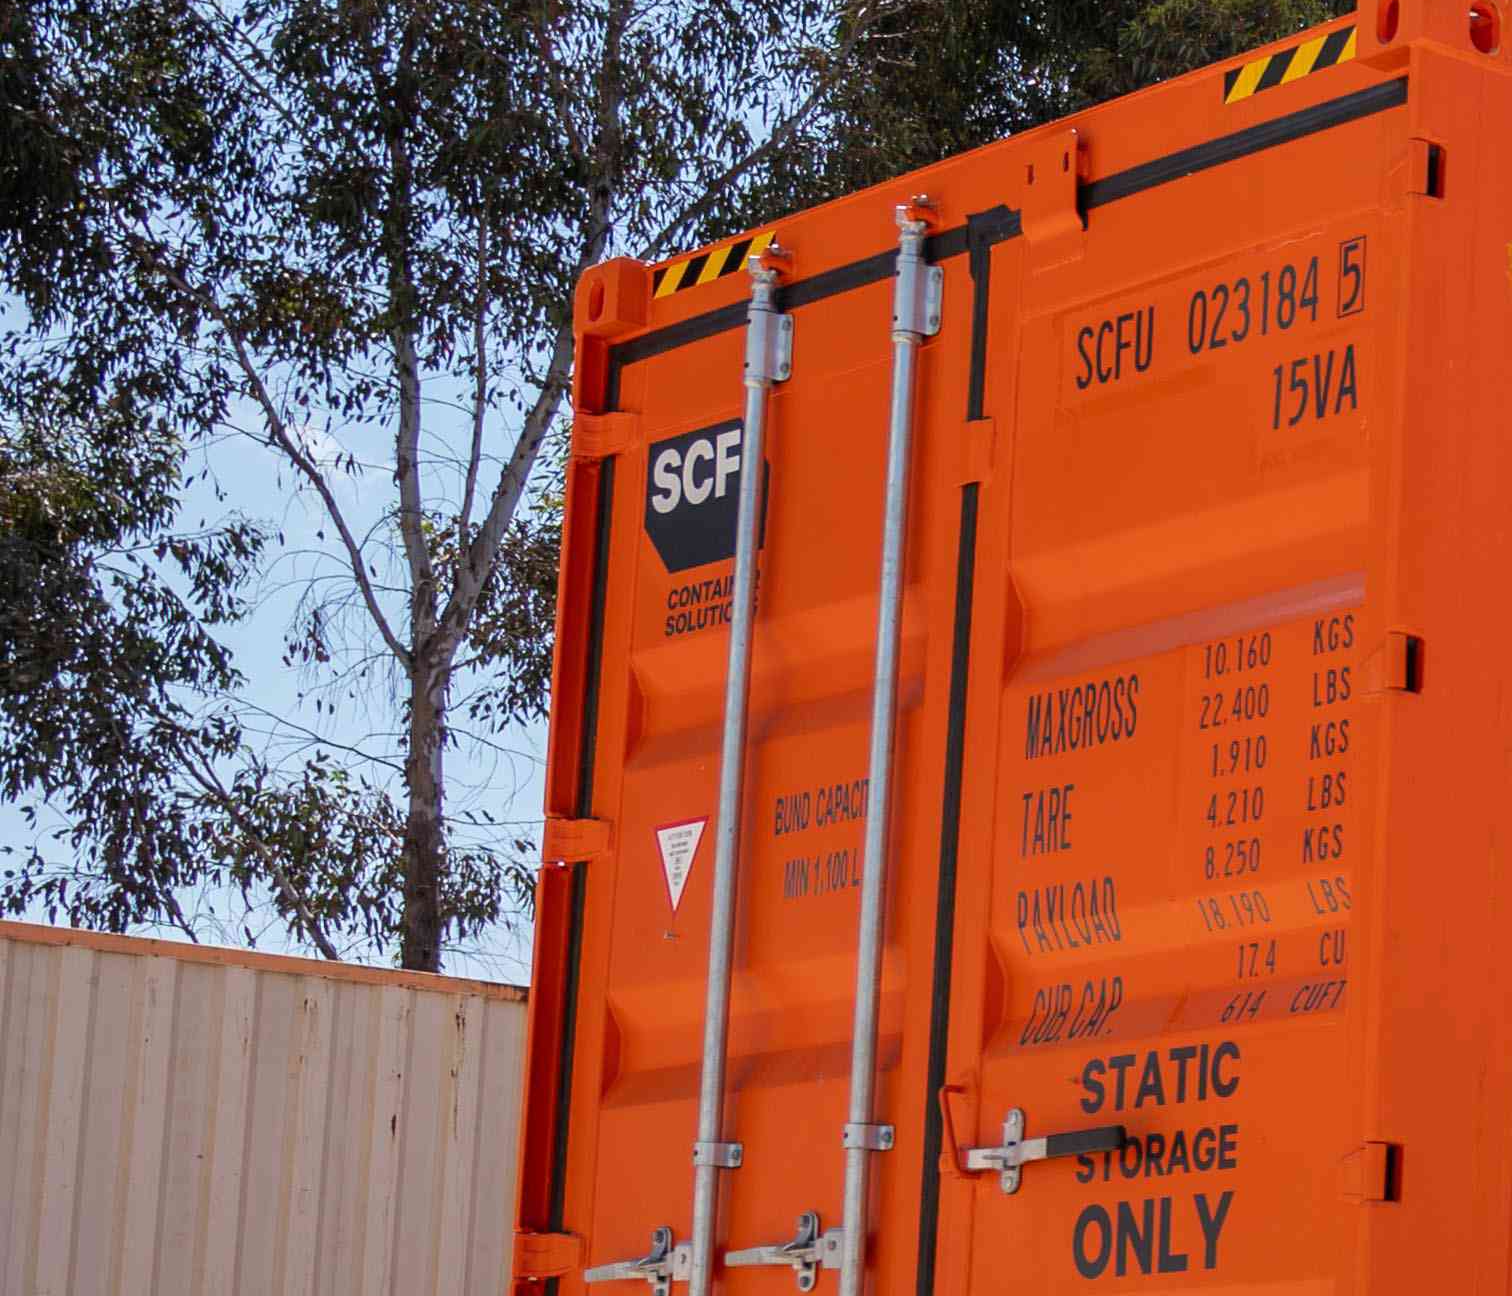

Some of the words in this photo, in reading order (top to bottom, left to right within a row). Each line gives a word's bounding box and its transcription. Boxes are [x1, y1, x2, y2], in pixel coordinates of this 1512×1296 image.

[1076, 306, 1154, 390] SCFU
[1187, 256, 1319, 355] 023184
[1273, 344, 1358, 430] 15VA
[651, 429, 741, 514] SCF
[1205, 632, 1272, 679] 10.160
[1313, 614, 1355, 655] KGS
[1026, 674, 1139, 760] MAXGROSS
[1200, 684, 1269, 730] 22.400
[1313, 667, 1352, 707] LBS
[1212, 735, 1267, 777] 1.910
[1310, 719, 1350, 760] KGS
[775, 790, 810, 836] BUND
[1022, 784, 1074, 857] TARE
[1207, 787, 1264, 828] 4.210
[1307, 771, 1346, 811] LBS
[784, 855, 809, 899] MIN
[1205, 837, 1261, 880] 8.250
[1303, 824, 1343, 864] KGS
[1018, 876, 1121, 955] PAYLOAD
[1198, 891, 1271, 932] 18.190
[1307, 876, 1352, 915] LBS
[1220, 990, 1266, 1024] 614
[1290, 980, 1347, 1013] CUFT
[1080, 1041, 1240, 1114] STATIC
[1073, 1191, 1234, 1279] ONLY
